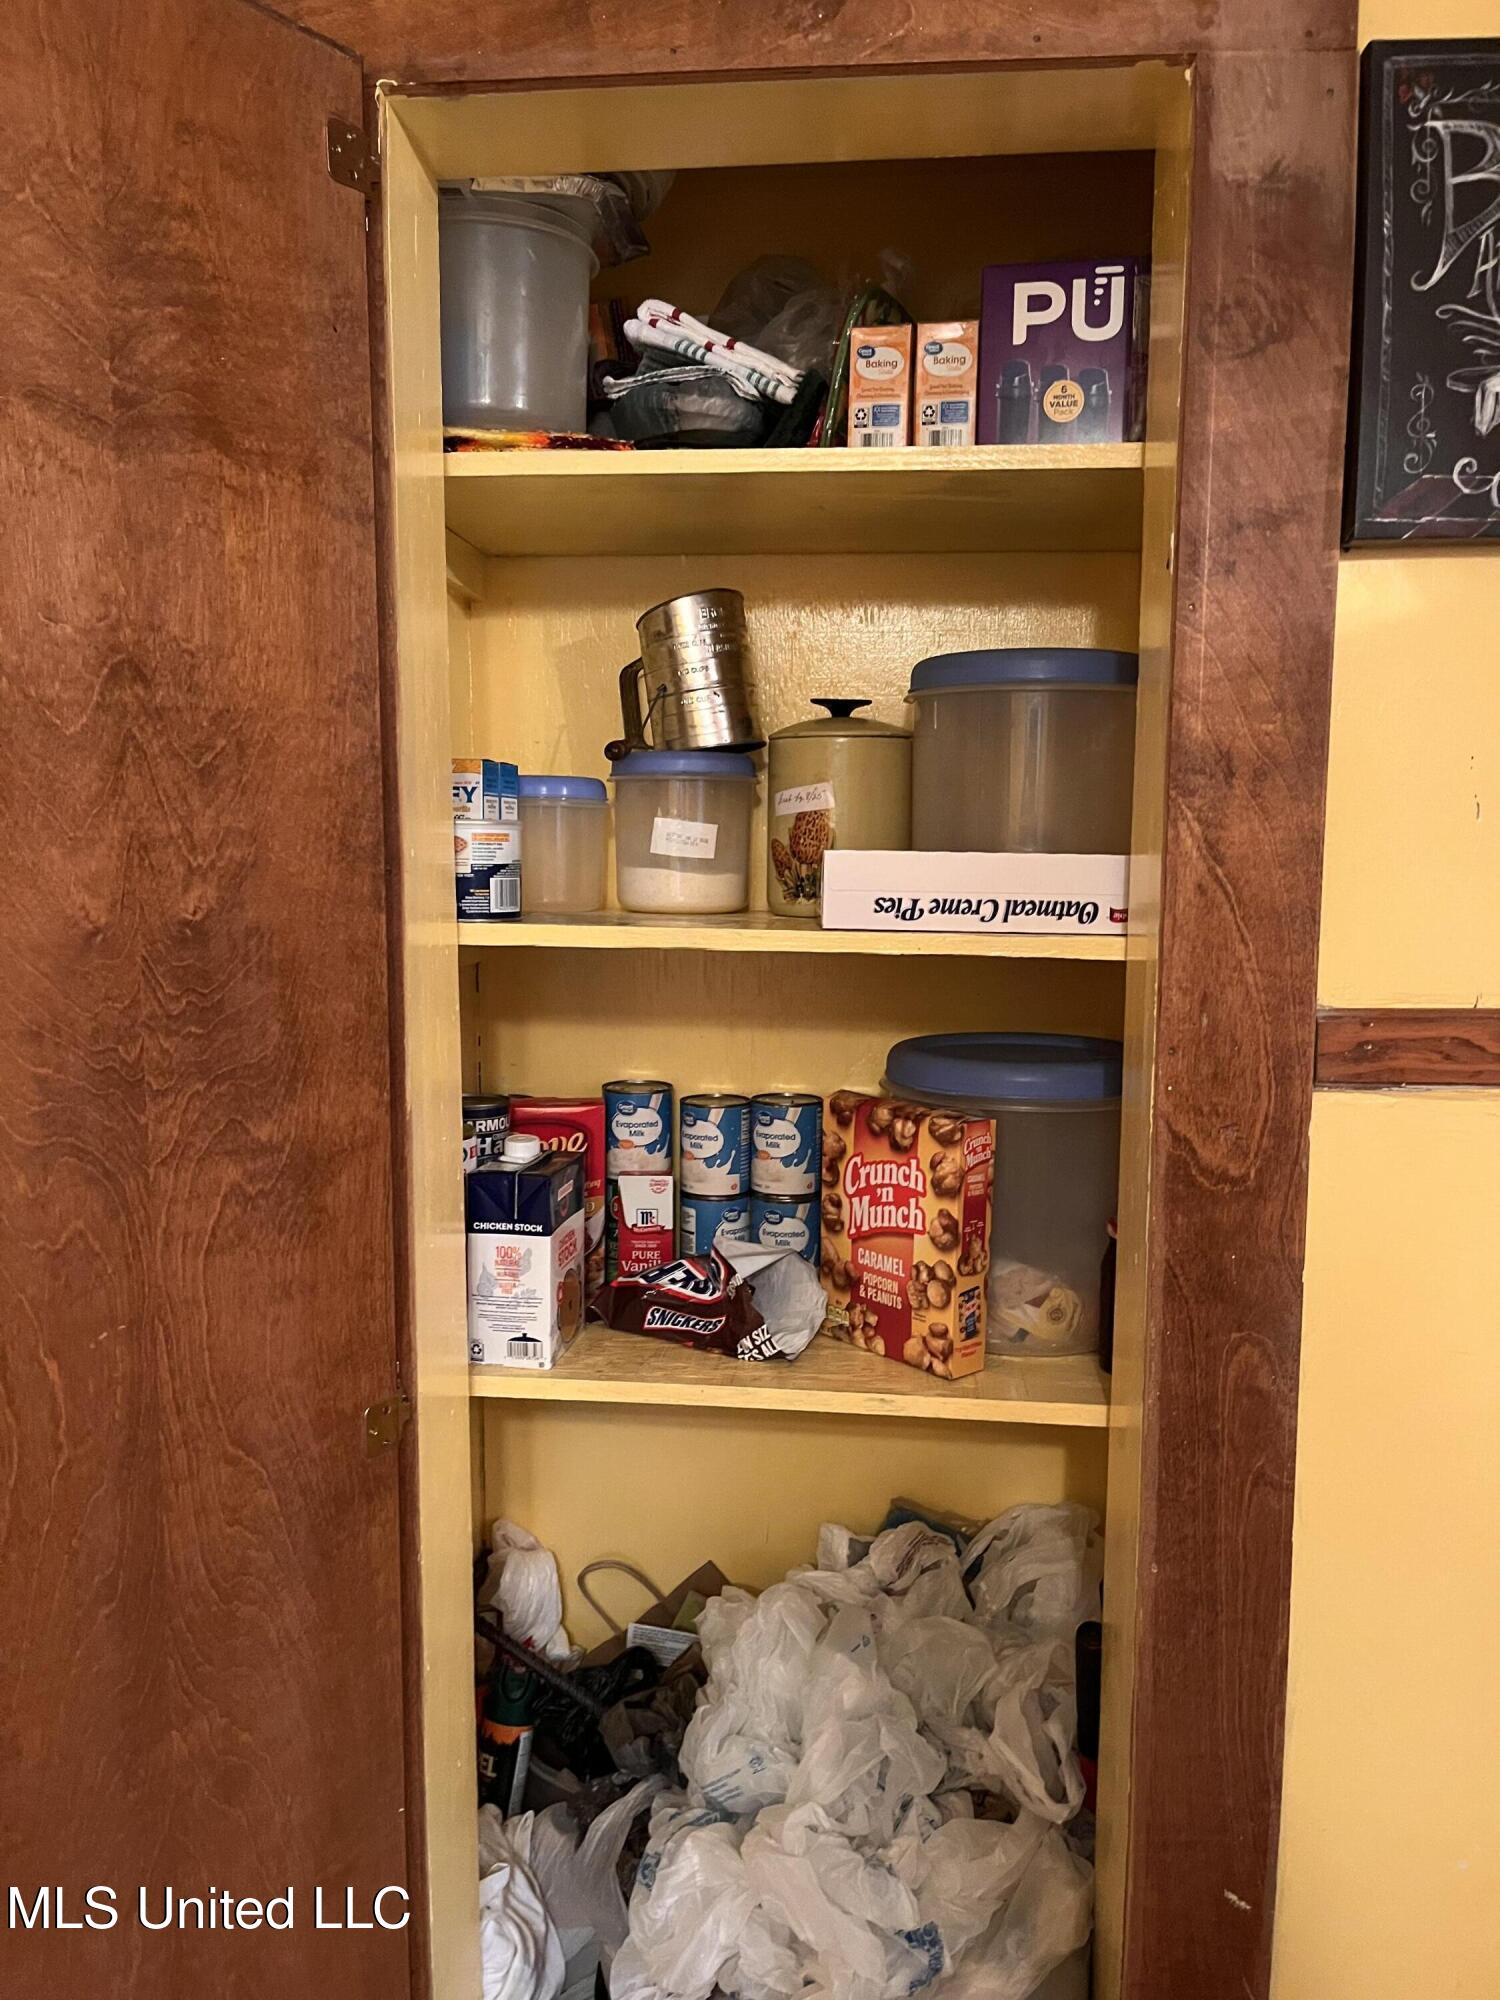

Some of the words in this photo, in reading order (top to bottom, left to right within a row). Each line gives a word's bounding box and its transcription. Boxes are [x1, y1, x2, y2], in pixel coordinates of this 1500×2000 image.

[865, 359, 898, 369] Baking
[933, 355, 967, 366] Baking
[1061, 385, 1068, 393] 6
[1050, 400, 1078, 408] VALUE
[874, 897, 924, 921] Pies
[929, 899, 999, 922] Creme
[1003, 900, 1099, 925] Oatmeal
[616, 1120, 659, 1130] Evaporated
[629, 1129, 645, 1137] Milk
[755, 1132, 796, 1142] Evaporated
[689, 1141, 704, 1149] Milk
[765, 1141, 781, 1149] Milk
[964, 1132, 992, 1156] Crunch
[846, 1155, 924, 1195] Crunch
[849, 1195, 924, 1235] Munch
[473, 1222, 513, 1231] CHICKEN
[514, 1223, 543, 1233] STOCK
[762, 1228, 806, 1239] Evaporated
[775, 1239, 791, 1247] Milk
[496, 1246, 522, 1260] 100%
[632, 1250, 661, 1260] PURE
[857, 1247, 905, 1277] CARAMEL
[863, 1271, 898, 1294] POPCORN
[859, 1284, 867, 1298] &
[867, 1286, 902, 1310] PEANUTS
[647, 1307, 722, 1333] SNICKERS
